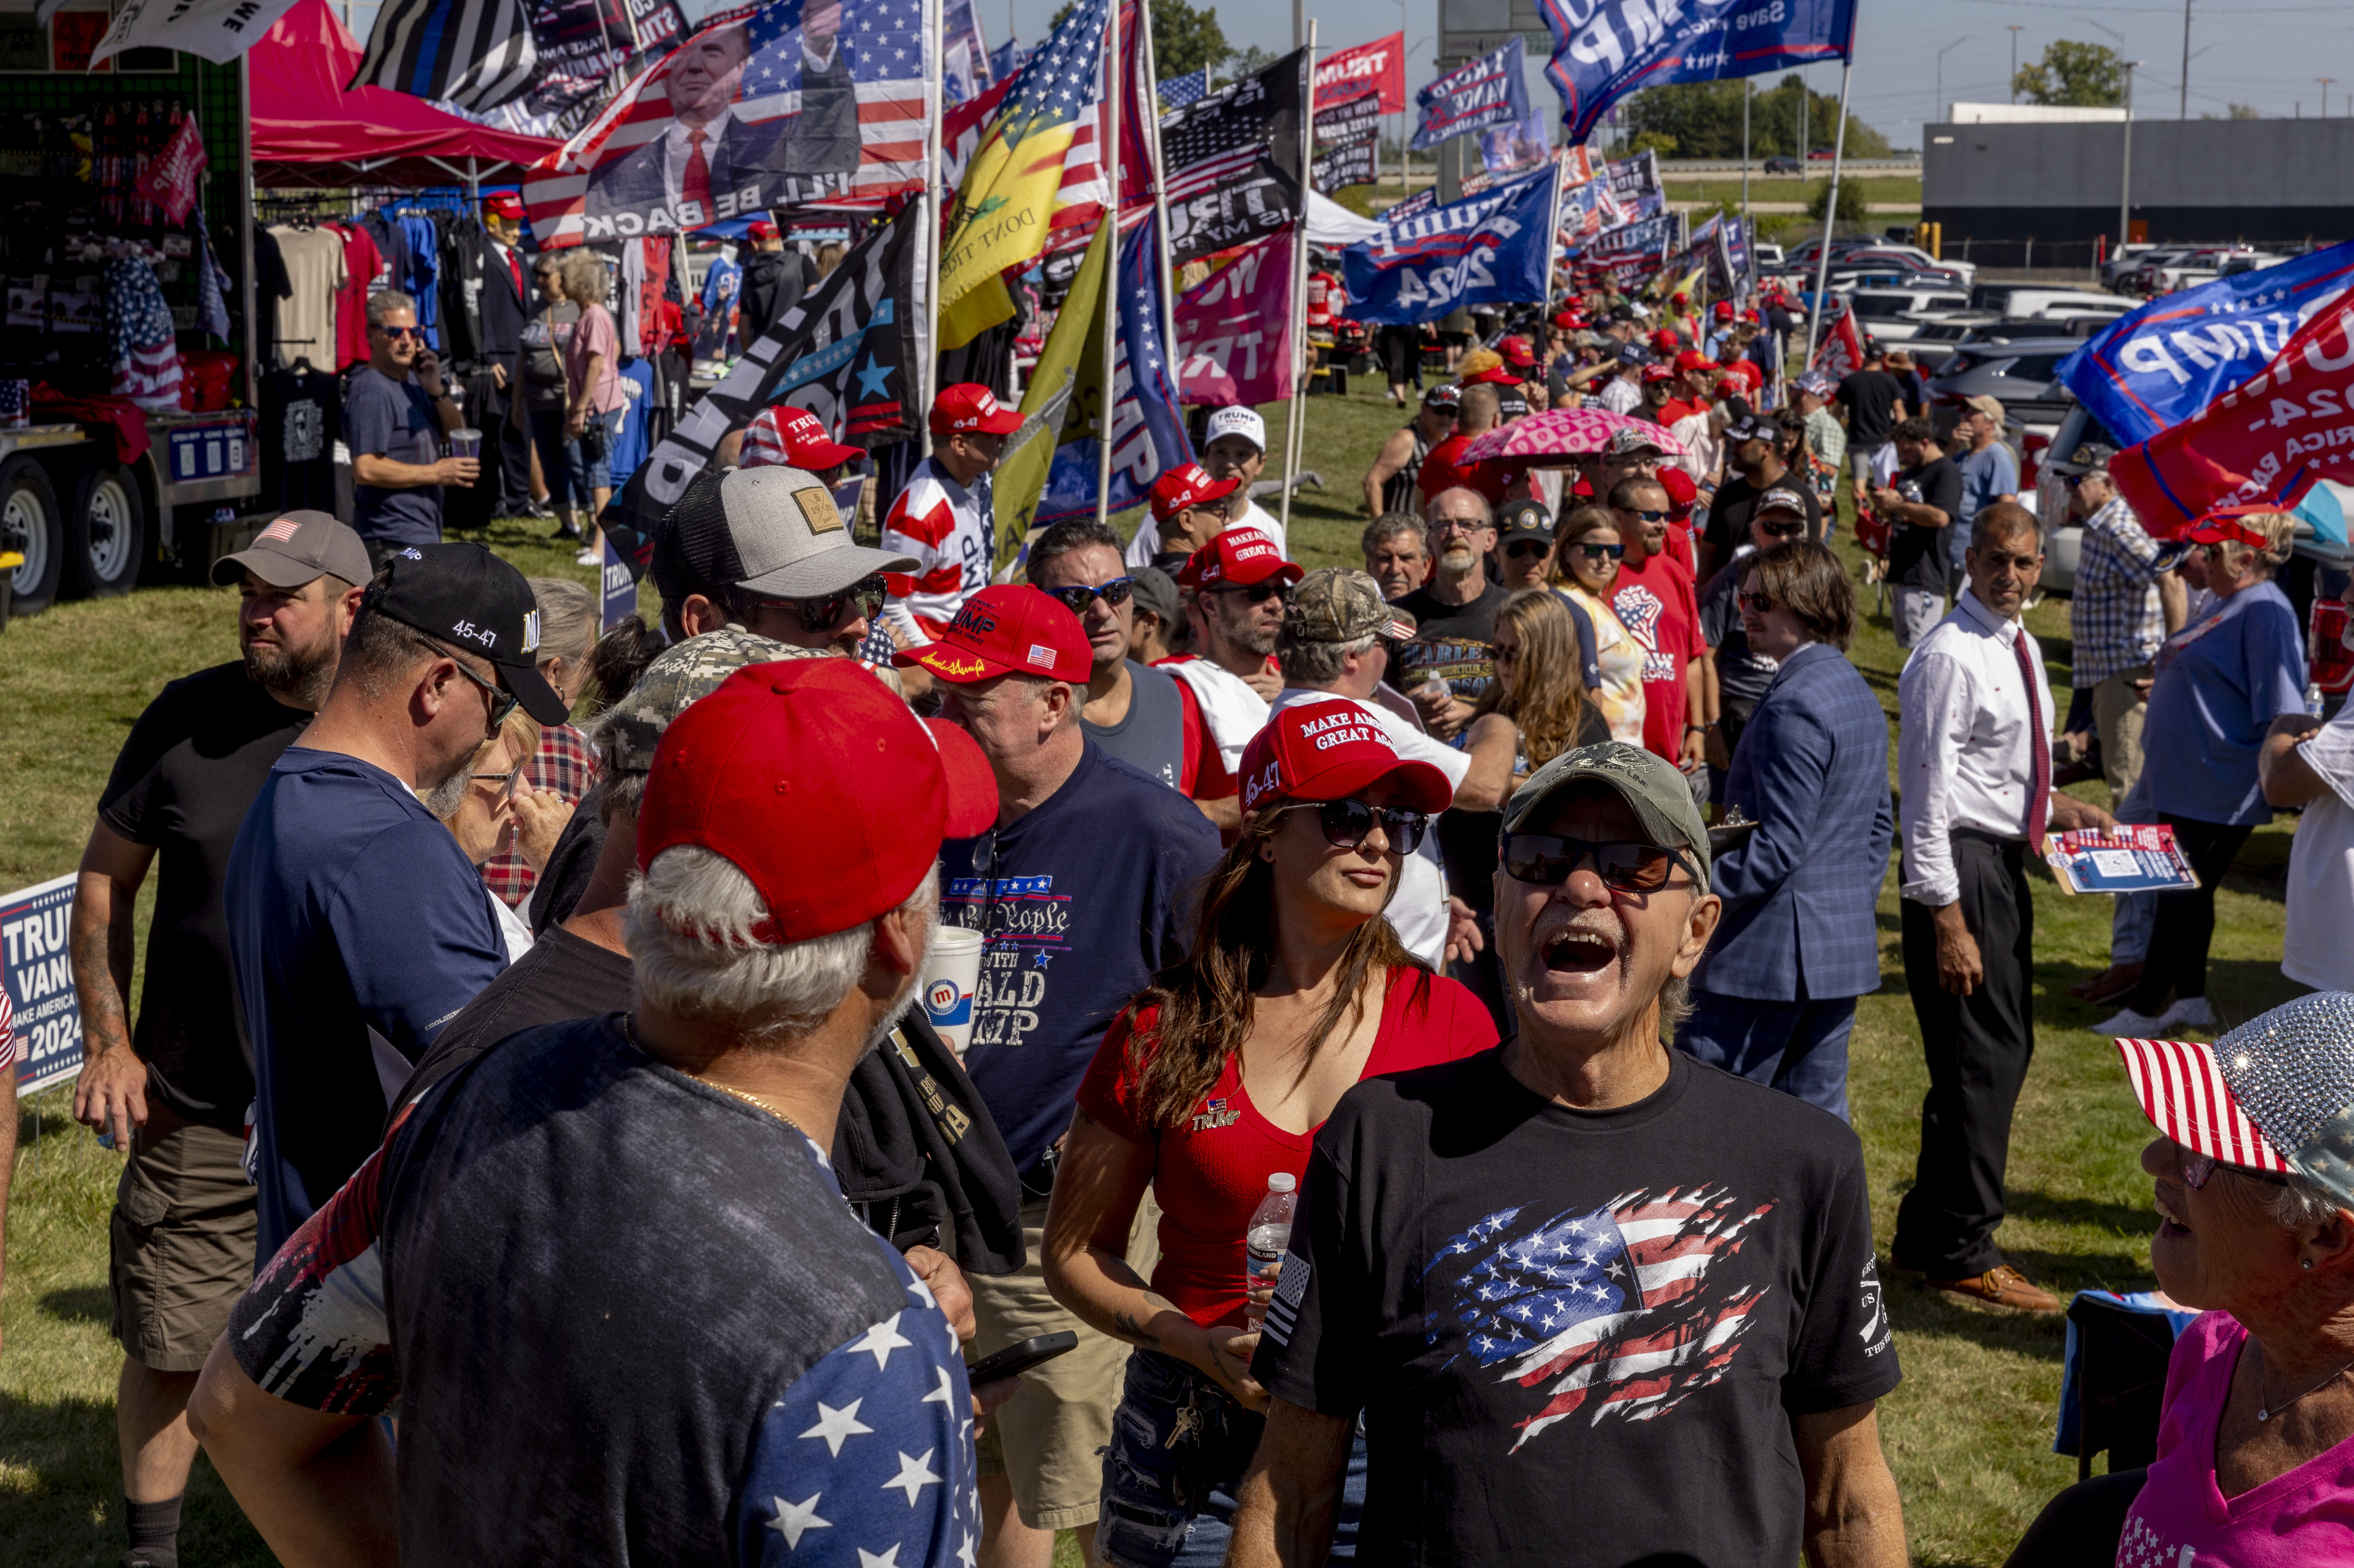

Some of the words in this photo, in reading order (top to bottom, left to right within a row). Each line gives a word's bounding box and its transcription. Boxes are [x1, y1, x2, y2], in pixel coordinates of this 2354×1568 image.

[1218, 411, 1256, 422] TRUMP
[810, 505, 821, 515] 19
[1226, 530, 1255, 547] MAKE
[1235, 544, 1267, 561] GREAT
[452, 619, 497, 648] 45-47
[964, 632, 985, 646] GREAT
[1300, 713, 1351, 738] MAKE
[1315, 727, 1370, 751] GREAT
[1245, 760, 1280, 807] 45-47
[1626, 769, 1649, 789] LINE
[993, 901, 1071, 938] People
[931, 979, 948, 988] MEIJER
[974, 969, 1046, 1008] ALD
[36, 992, 76, 1020] AMERICA
[936, 1002, 957, 1014] EXPRESS
[30, 1013, 83, 1063] 2024
[1192, 1109, 1241, 1132] TRUMP
[1860, 1292, 1875, 1308] US
[1864, 1336, 1887, 1358] THIS
